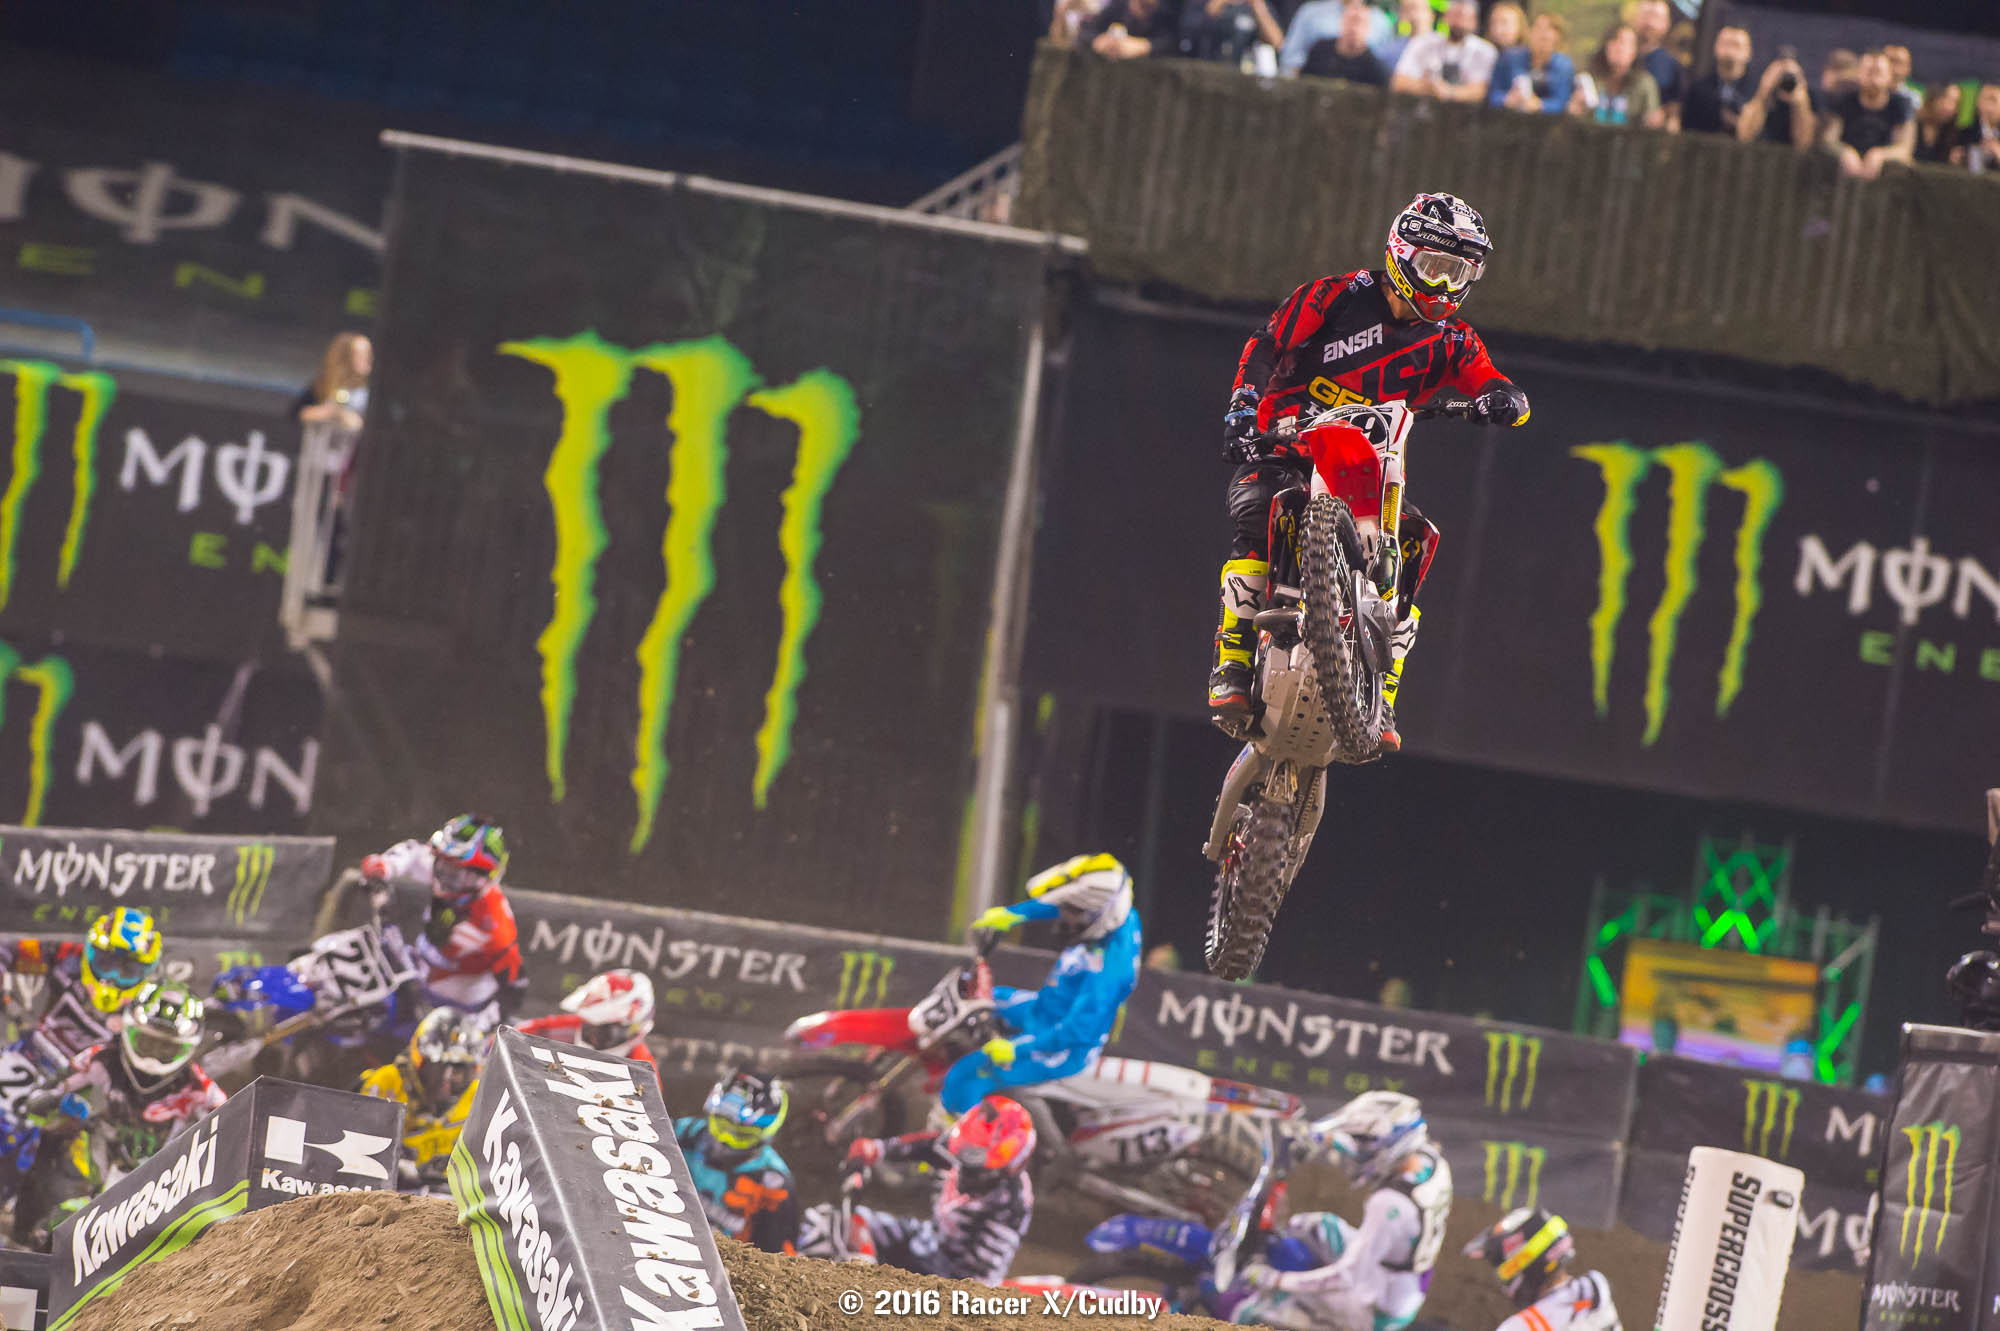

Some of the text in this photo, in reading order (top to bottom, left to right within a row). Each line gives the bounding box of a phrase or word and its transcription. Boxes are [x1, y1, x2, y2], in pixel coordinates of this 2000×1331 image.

[14, 840, 216, 898] MONSTER
[530, 919, 808, 992] MONSTER
[1157, 989, 1455, 1075] MONSTER
[72, 1114, 219, 1287] Kawasaki
[483, 1087, 585, 1331] Kawasaki
